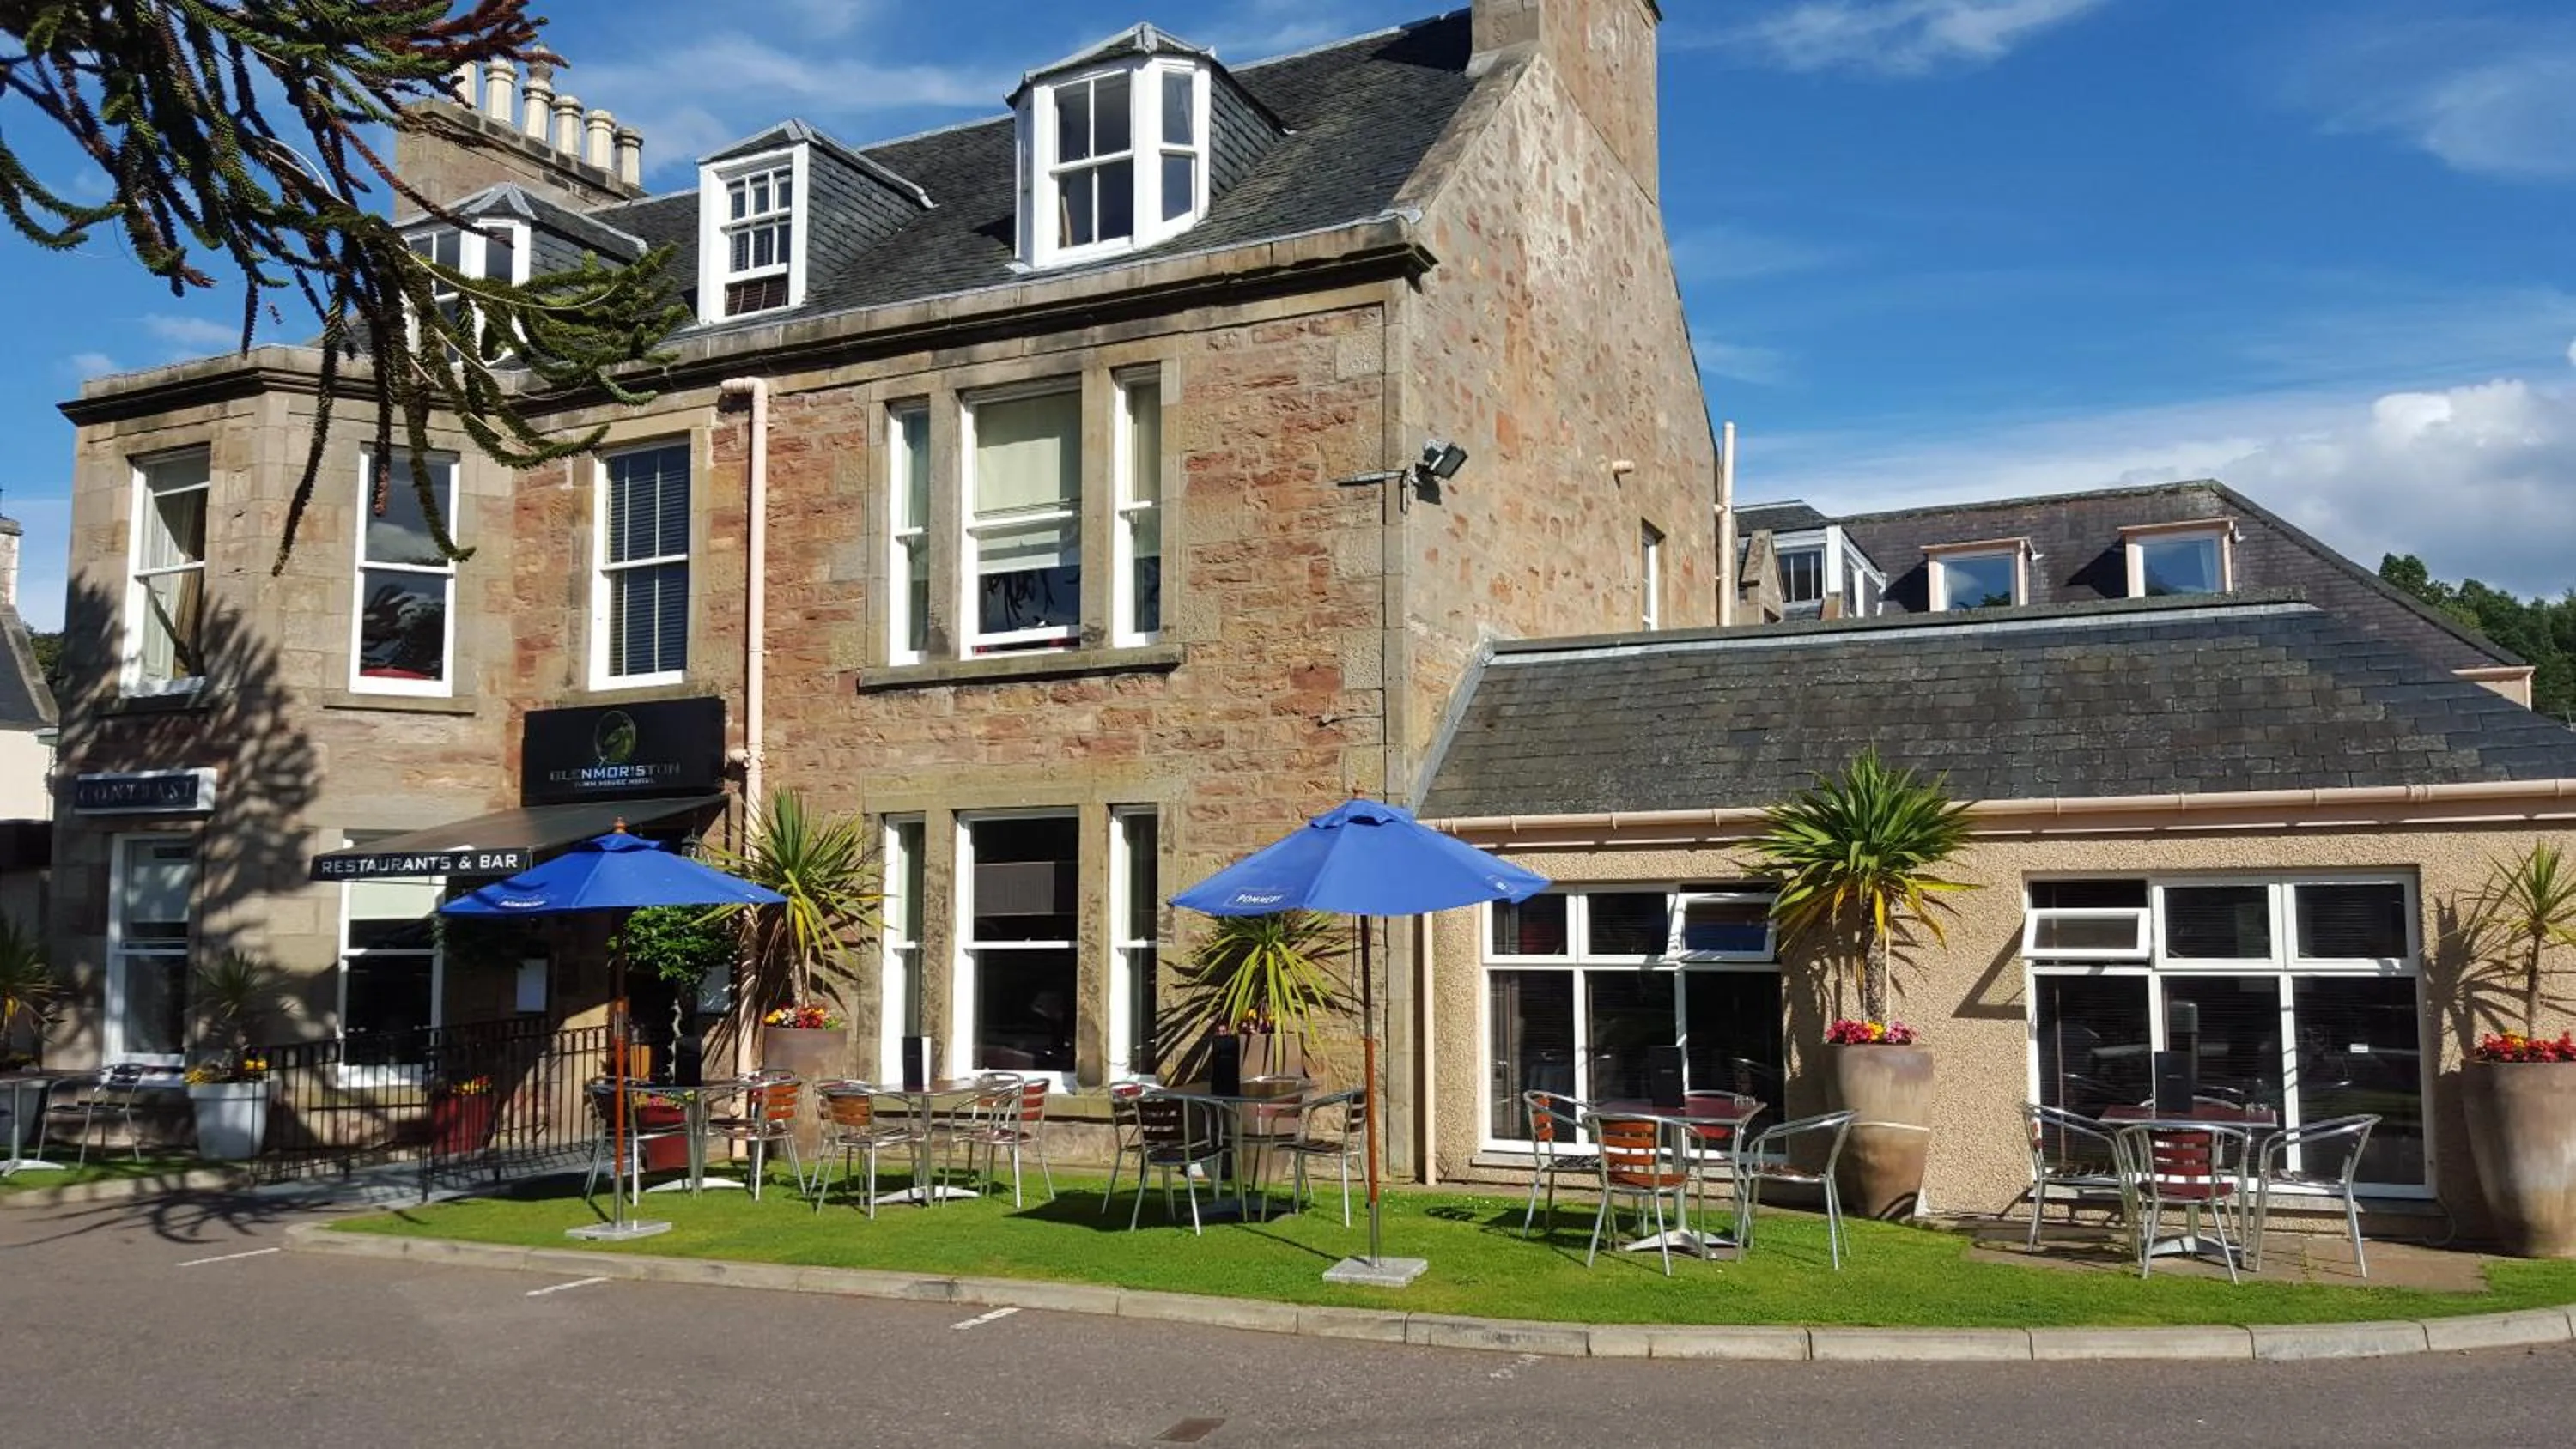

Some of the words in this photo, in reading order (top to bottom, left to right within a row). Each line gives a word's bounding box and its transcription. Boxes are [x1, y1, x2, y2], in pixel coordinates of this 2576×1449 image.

[322, 857, 451, 873] RESTAURANTS
[459, 857, 471, 870] &
[479, 854, 519, 870] BAR
